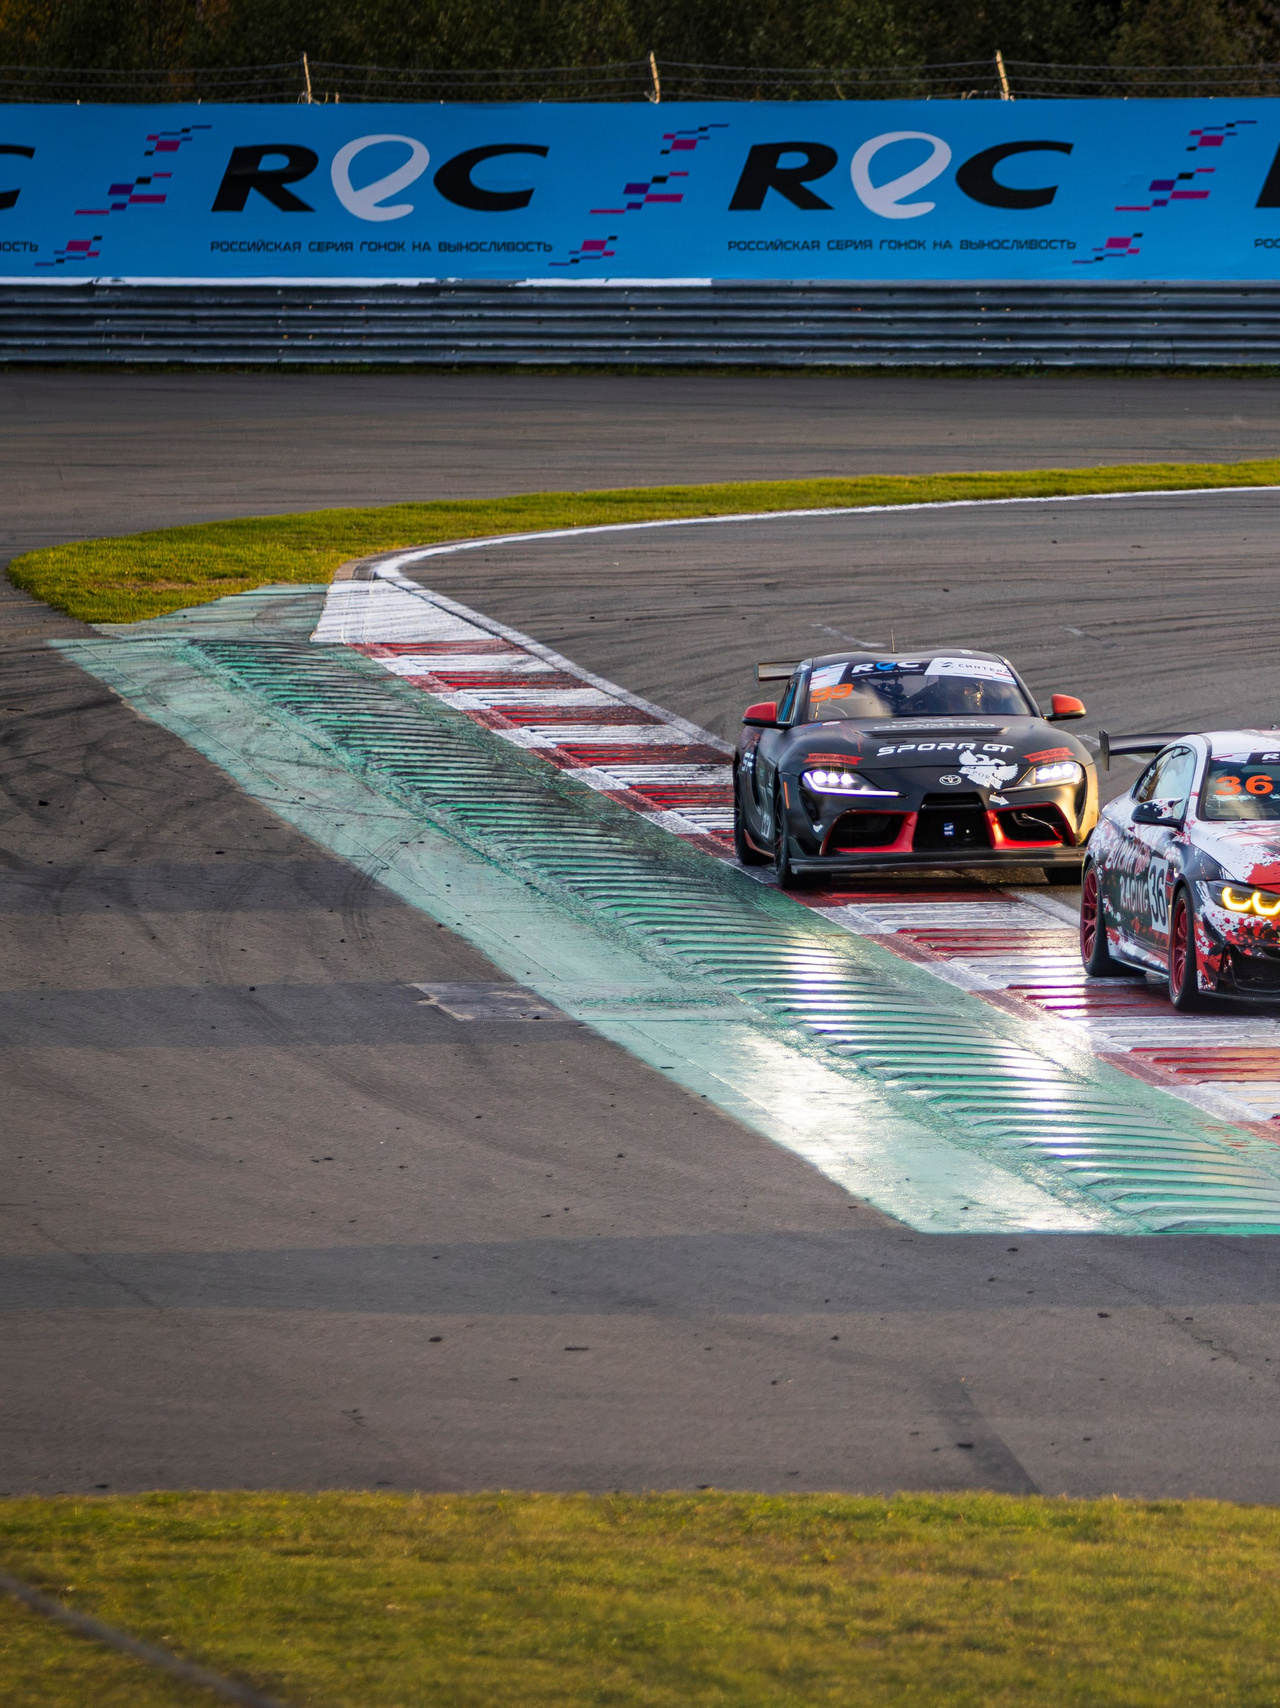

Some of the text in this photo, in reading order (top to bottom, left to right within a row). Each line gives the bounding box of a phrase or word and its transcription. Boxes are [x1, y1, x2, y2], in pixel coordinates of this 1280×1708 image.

[210, 239, 553, 252] РОССИЙСКАЯ СЕРИЯ ГОНОК НА ВЫНОСЛИВОСТЬ
[728, 239, 1076, 250] РОССИЙСКАЯ СЕРИЯ ГОНОК НА ВЫНОСЛИВОСТЬ
[958, 663, 1010, 675] СИНТЕРА
[809, 683, 854, 703] 99
[877, 742, 1014, 757] SPORA GT
[1215, 775, 1273, 796] 36
[1120, 875, 1149, 914] RACING
[1149, 864, 1166, 927] 36
